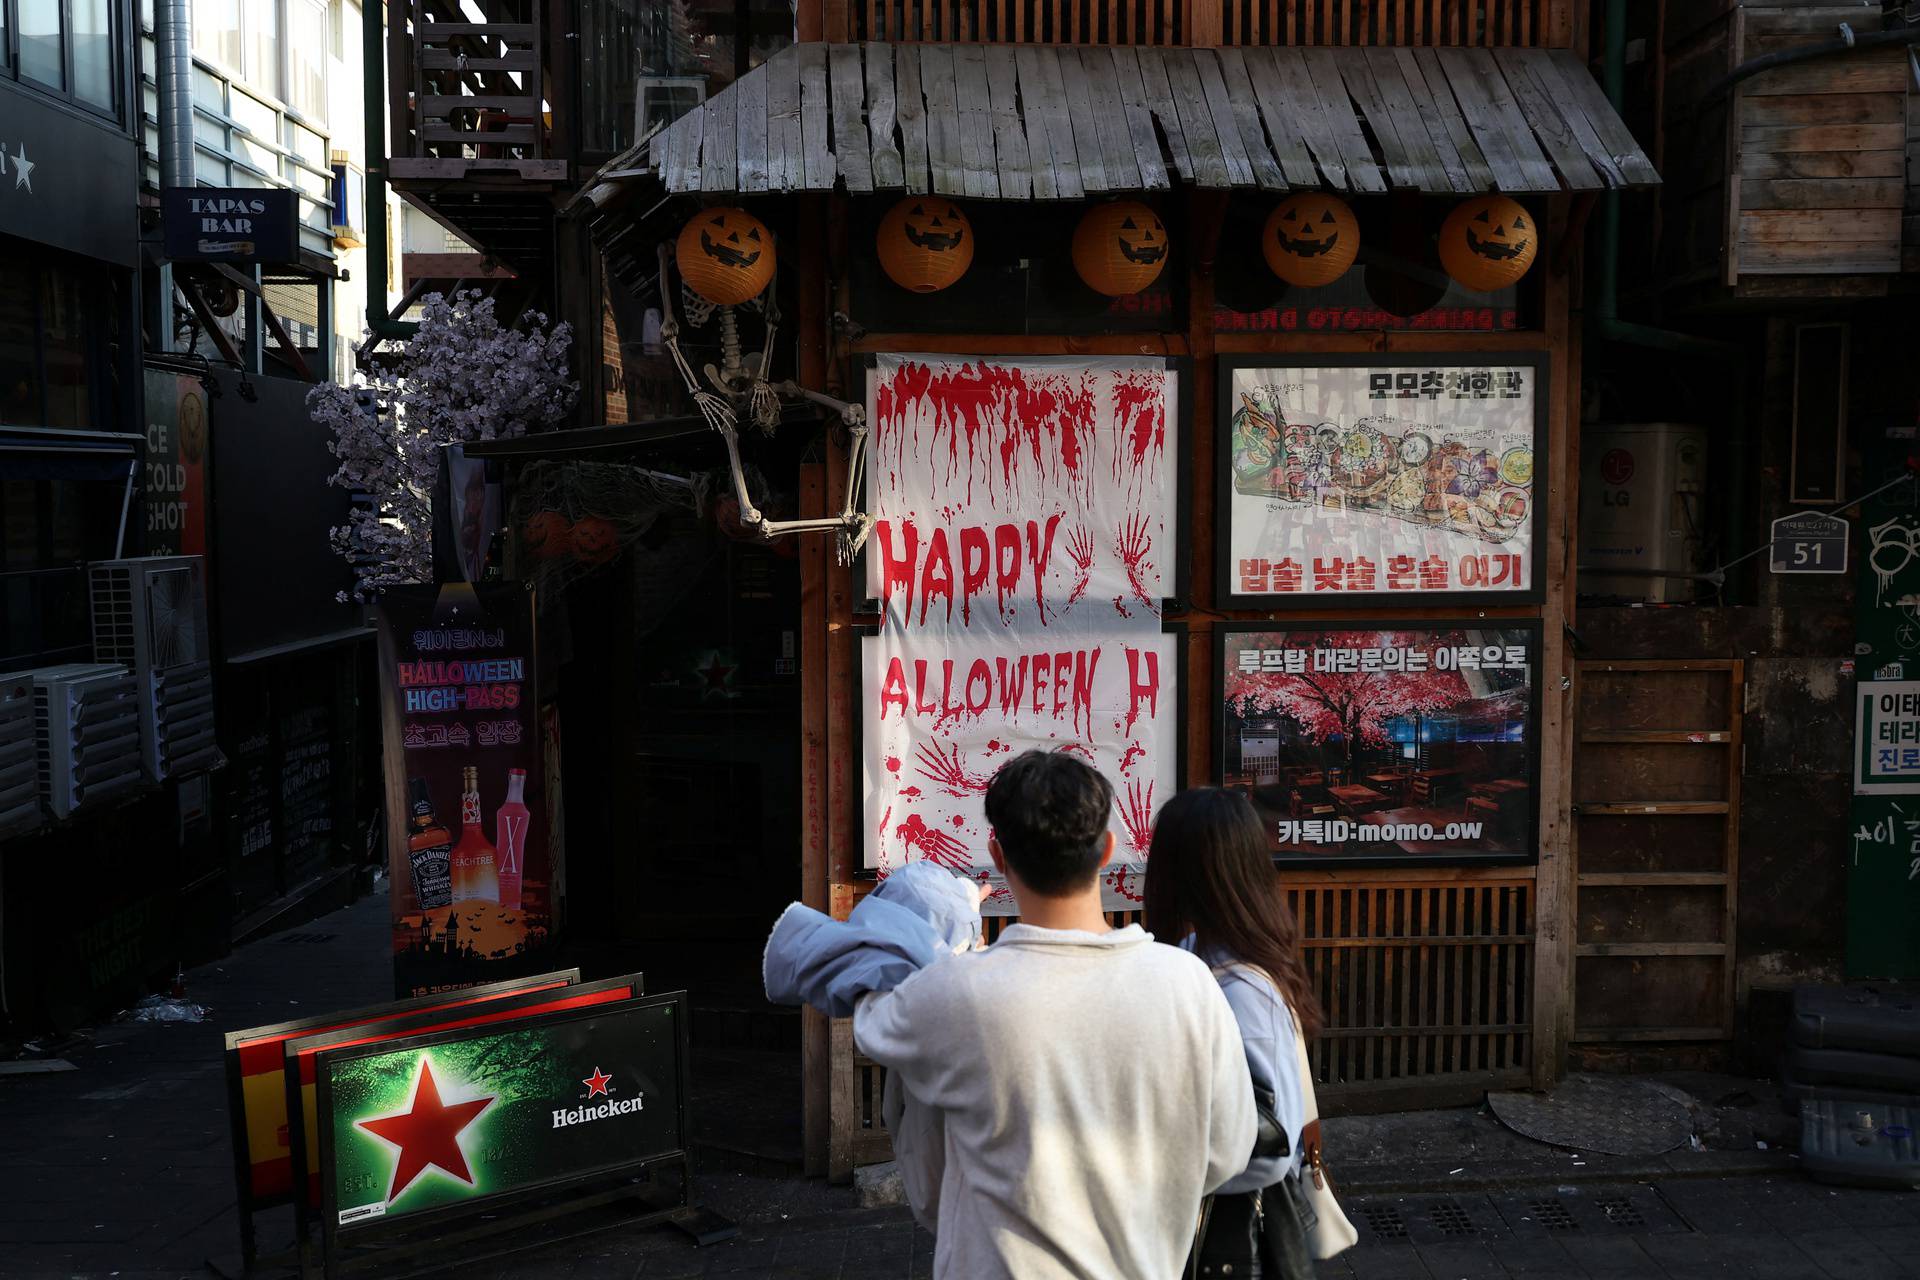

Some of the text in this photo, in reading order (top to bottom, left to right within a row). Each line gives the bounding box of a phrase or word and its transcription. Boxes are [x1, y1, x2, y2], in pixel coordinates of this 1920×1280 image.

[187, 198, 265, 215] TAPAS
[200, 217, 252, 234] BAR
[1368, 370, 1524, 400] 모모추천한판
[147, 424, 168, 453] CE
[1603, 491, 1630, 507] LG
[1794, 542, 1822, 565] 51
[876, 511, 1066, 628] HAPPY
[1459, 554, 1521, 588] 여기
[398, 658, 525, 686] HALLOWEEN
[1238, 644, 1526, 674] 루프탑 대관문의는 이쪽으로
[404, 684, 521, 713] HIGH-PASS
[403, 720, 521, 748] 초고속 입장
[1278, 820, 1483, 845] 카톡ID:momo_ow
[552, 1098, 643, 1129] Heineken
